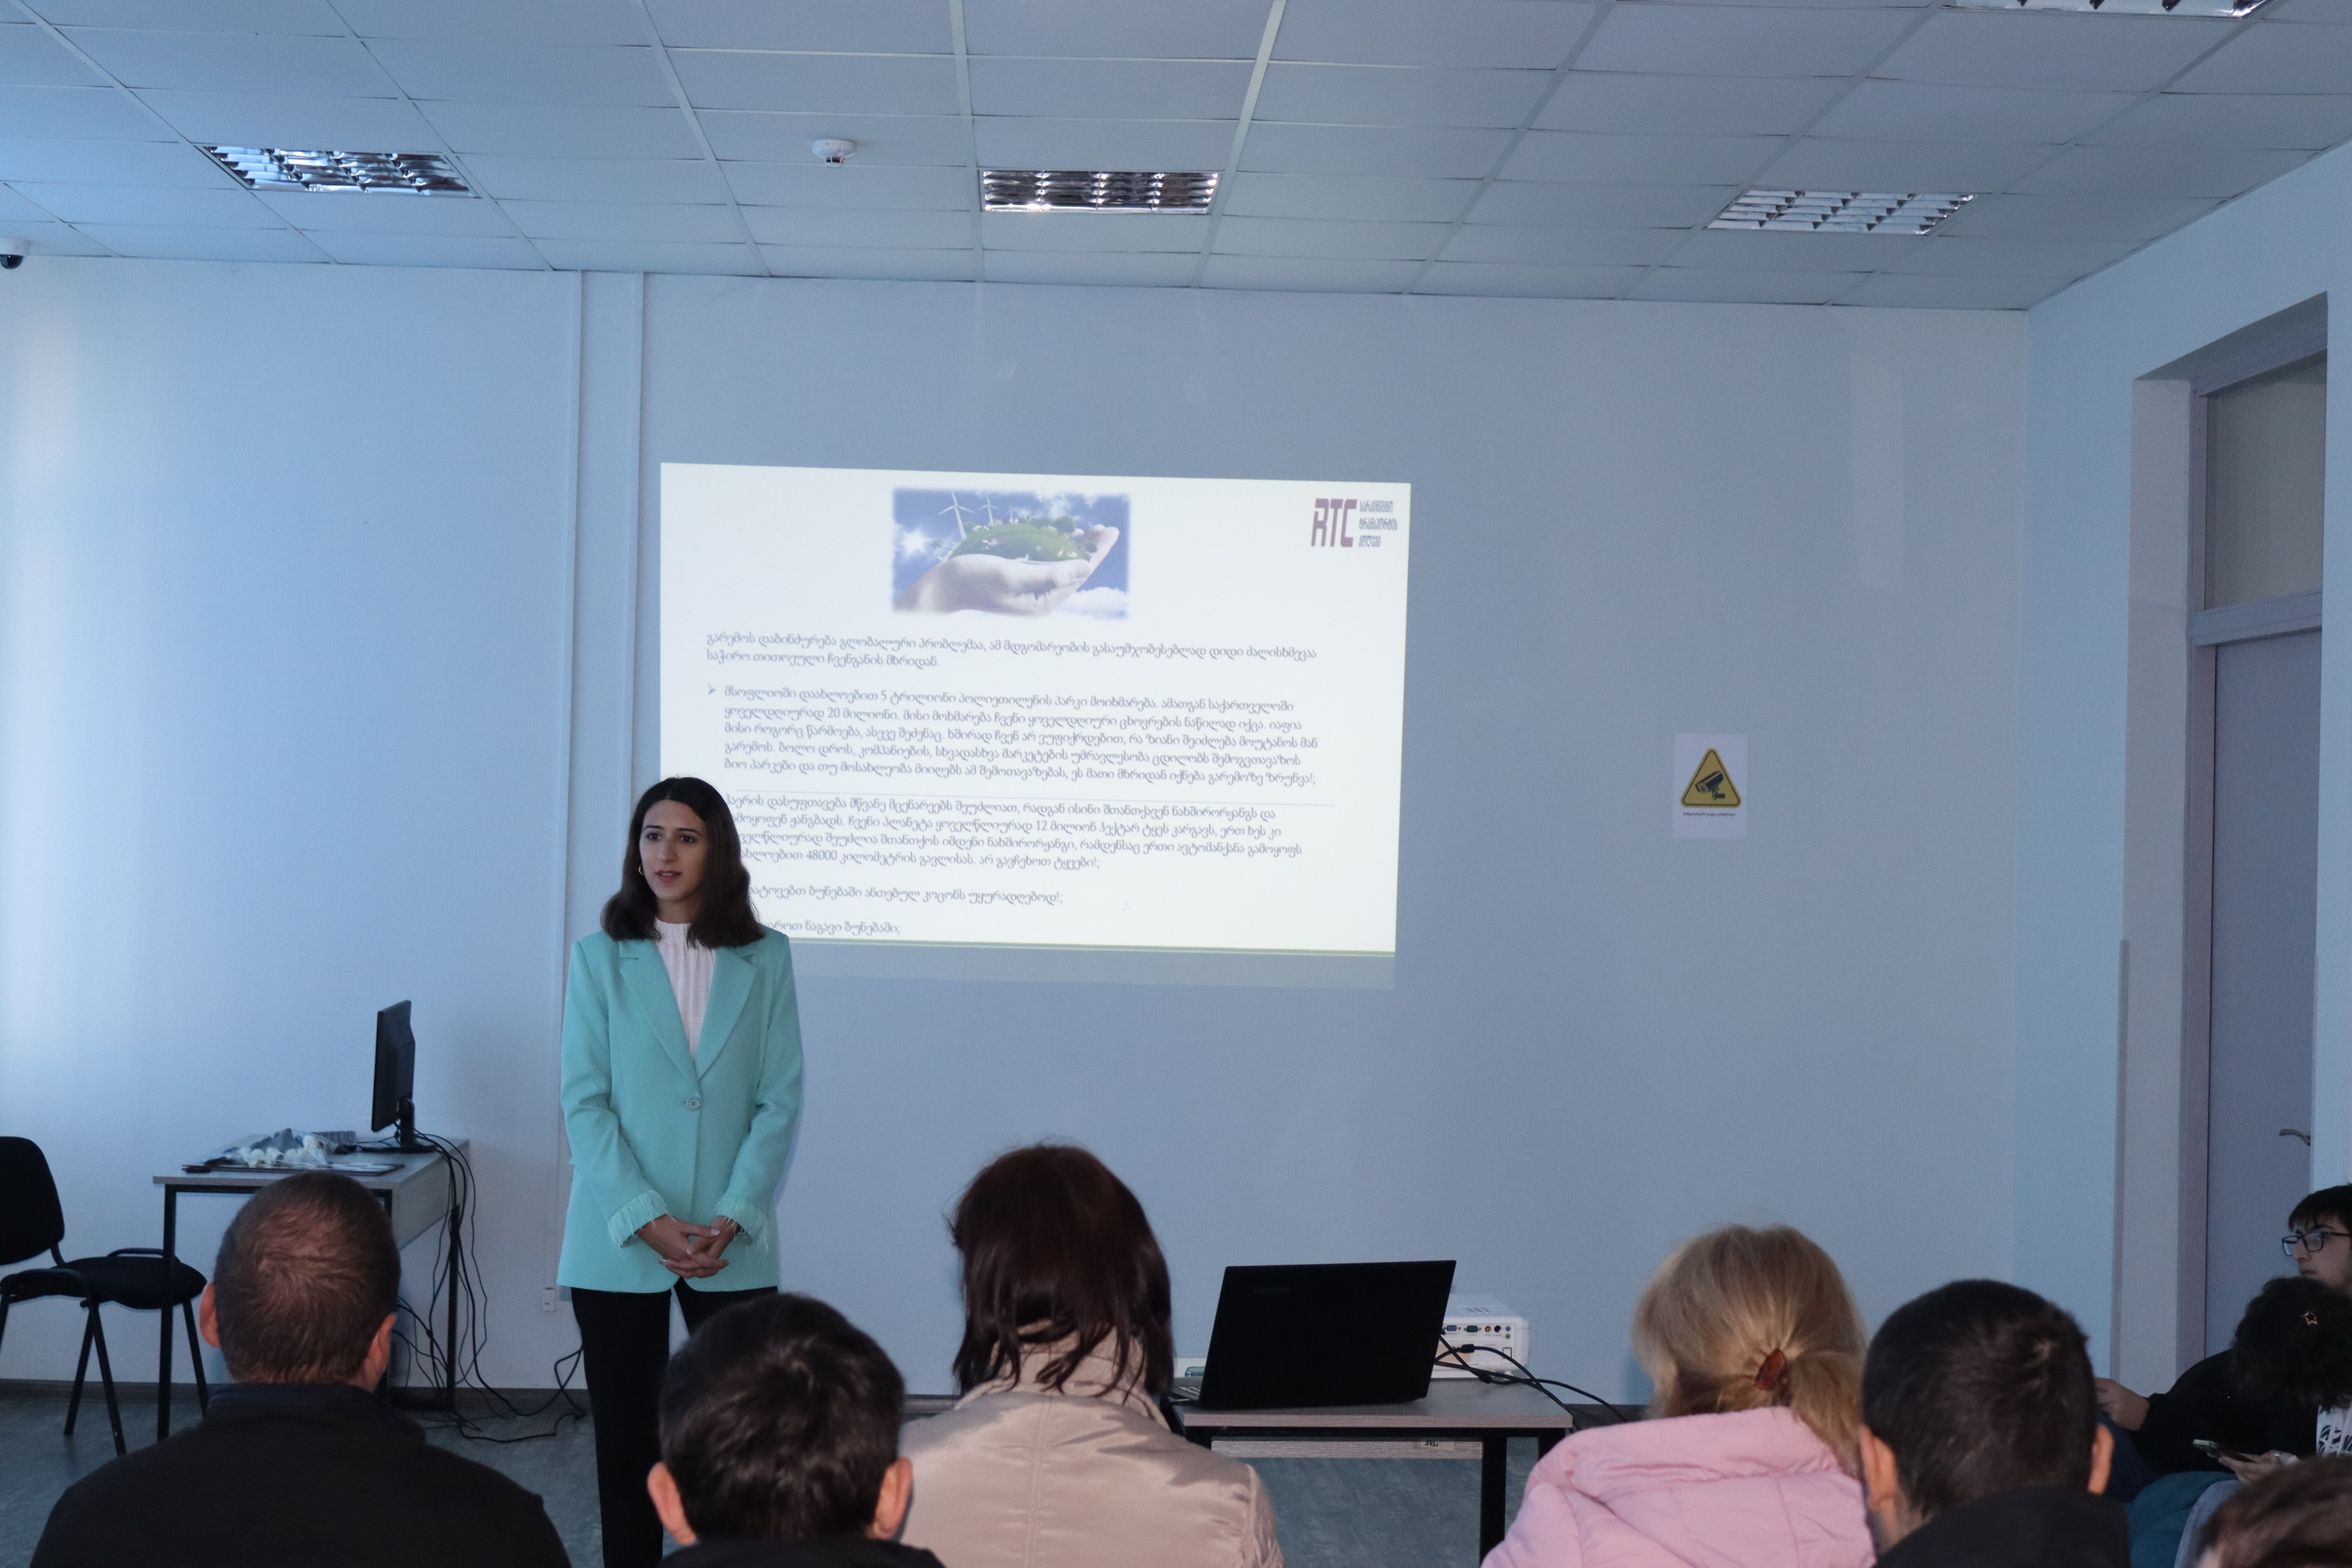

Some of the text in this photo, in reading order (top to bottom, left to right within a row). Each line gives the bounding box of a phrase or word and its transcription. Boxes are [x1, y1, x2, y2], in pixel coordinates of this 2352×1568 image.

[1311, 498, 1358, 547] RTC
[706, 631, 757, 647] გარემოს
[989, 639, 1002, 651] ამ
[1208, 648, 1245, 661] დიდი
[706, 648, 751, 665] საჭირო
[880, 689, 888, 702] 5
[1054, 695, 1088, 711] პარკი
[1160, 697, 1207, 713] ამათგან
[827, 706, 841, 718] 20
[902, 709, 930, 720] მისი
[993, 711, 1026, 728] ჩვენი
[1184, 716, 1236, 733] ნაწილად
[1238, 717, 1267, 733] იქცა.
[1269, 720, 1303, 735] იაფია
[724, 721, 752, 734] მისი
[753, 724, 804, 739] როგორც
[866, 725, 896, 742] ასევე
[947, 728, 993, 745] ხშირად
[994, 729, 1020, 745] ჩვენ
[1022, 731, 1036, 742] არ
[1128, 733, 1144, 745] რა
[1145, 733, 1181, 745] ზიანი
[1299, 736, 1319, 749] მან
[778, 741, 816, 757] ბოლო
[818, 742, 856, 758] დროს,
[1152, 752, 1210, 768] ცდილობს
[724, 757, 748, 769] ბიო
[749, 758, 797, 775] პარკები
[797, 762, 816, 775] და
[816, 763, 839, 776] თუ
[913, 762, 963, 779] მიიღებს
[964, 764, 978, 776] ამ
[1070, 766, 1084, 782] ეს
[1085, 767, 1116, 779] მათი
[1116, 768, 1168, 785] მხრიდან
[1168, 769, 1207, 786] იქნება
[849, 797, 887, 813] მწვანე
[1022, 801, 1066, 818] რადგან
[1067, 802, 1102, 815] ისინი
[1259, 810, 1276, 823] და
[848, 815, 880, 830] ჩვენი
[883, 816, 933, 832] პლანეტა
[1036, 819, 1048, 831] 12
[1050, 820, 1097, 835] მილიონ
[1099, 821, 1140, 837] ჰექტარ
[1142, 822, 1170, 838] ტყეს
[1220, 825, 1246, 840] ერთ
[1247, 824, 1267, 840] ხეს
[1268, 828, 1283, 840] კი
[826, 832, 878, 848] შეუძლია
[942, 835, 985, 851] იმდენი
[1142, 840, 1175, 855] ერთი
[805, 848, 838, 862] 48000
[978, 854, 995, 866] არ
[864, 886, 921, 903] ანთებულ
[921, 888, 967, 904] კოცონს
[804, 920, 843, 934] ნაგავი
[1254, 1286, 1291, 1295] Lenovo
